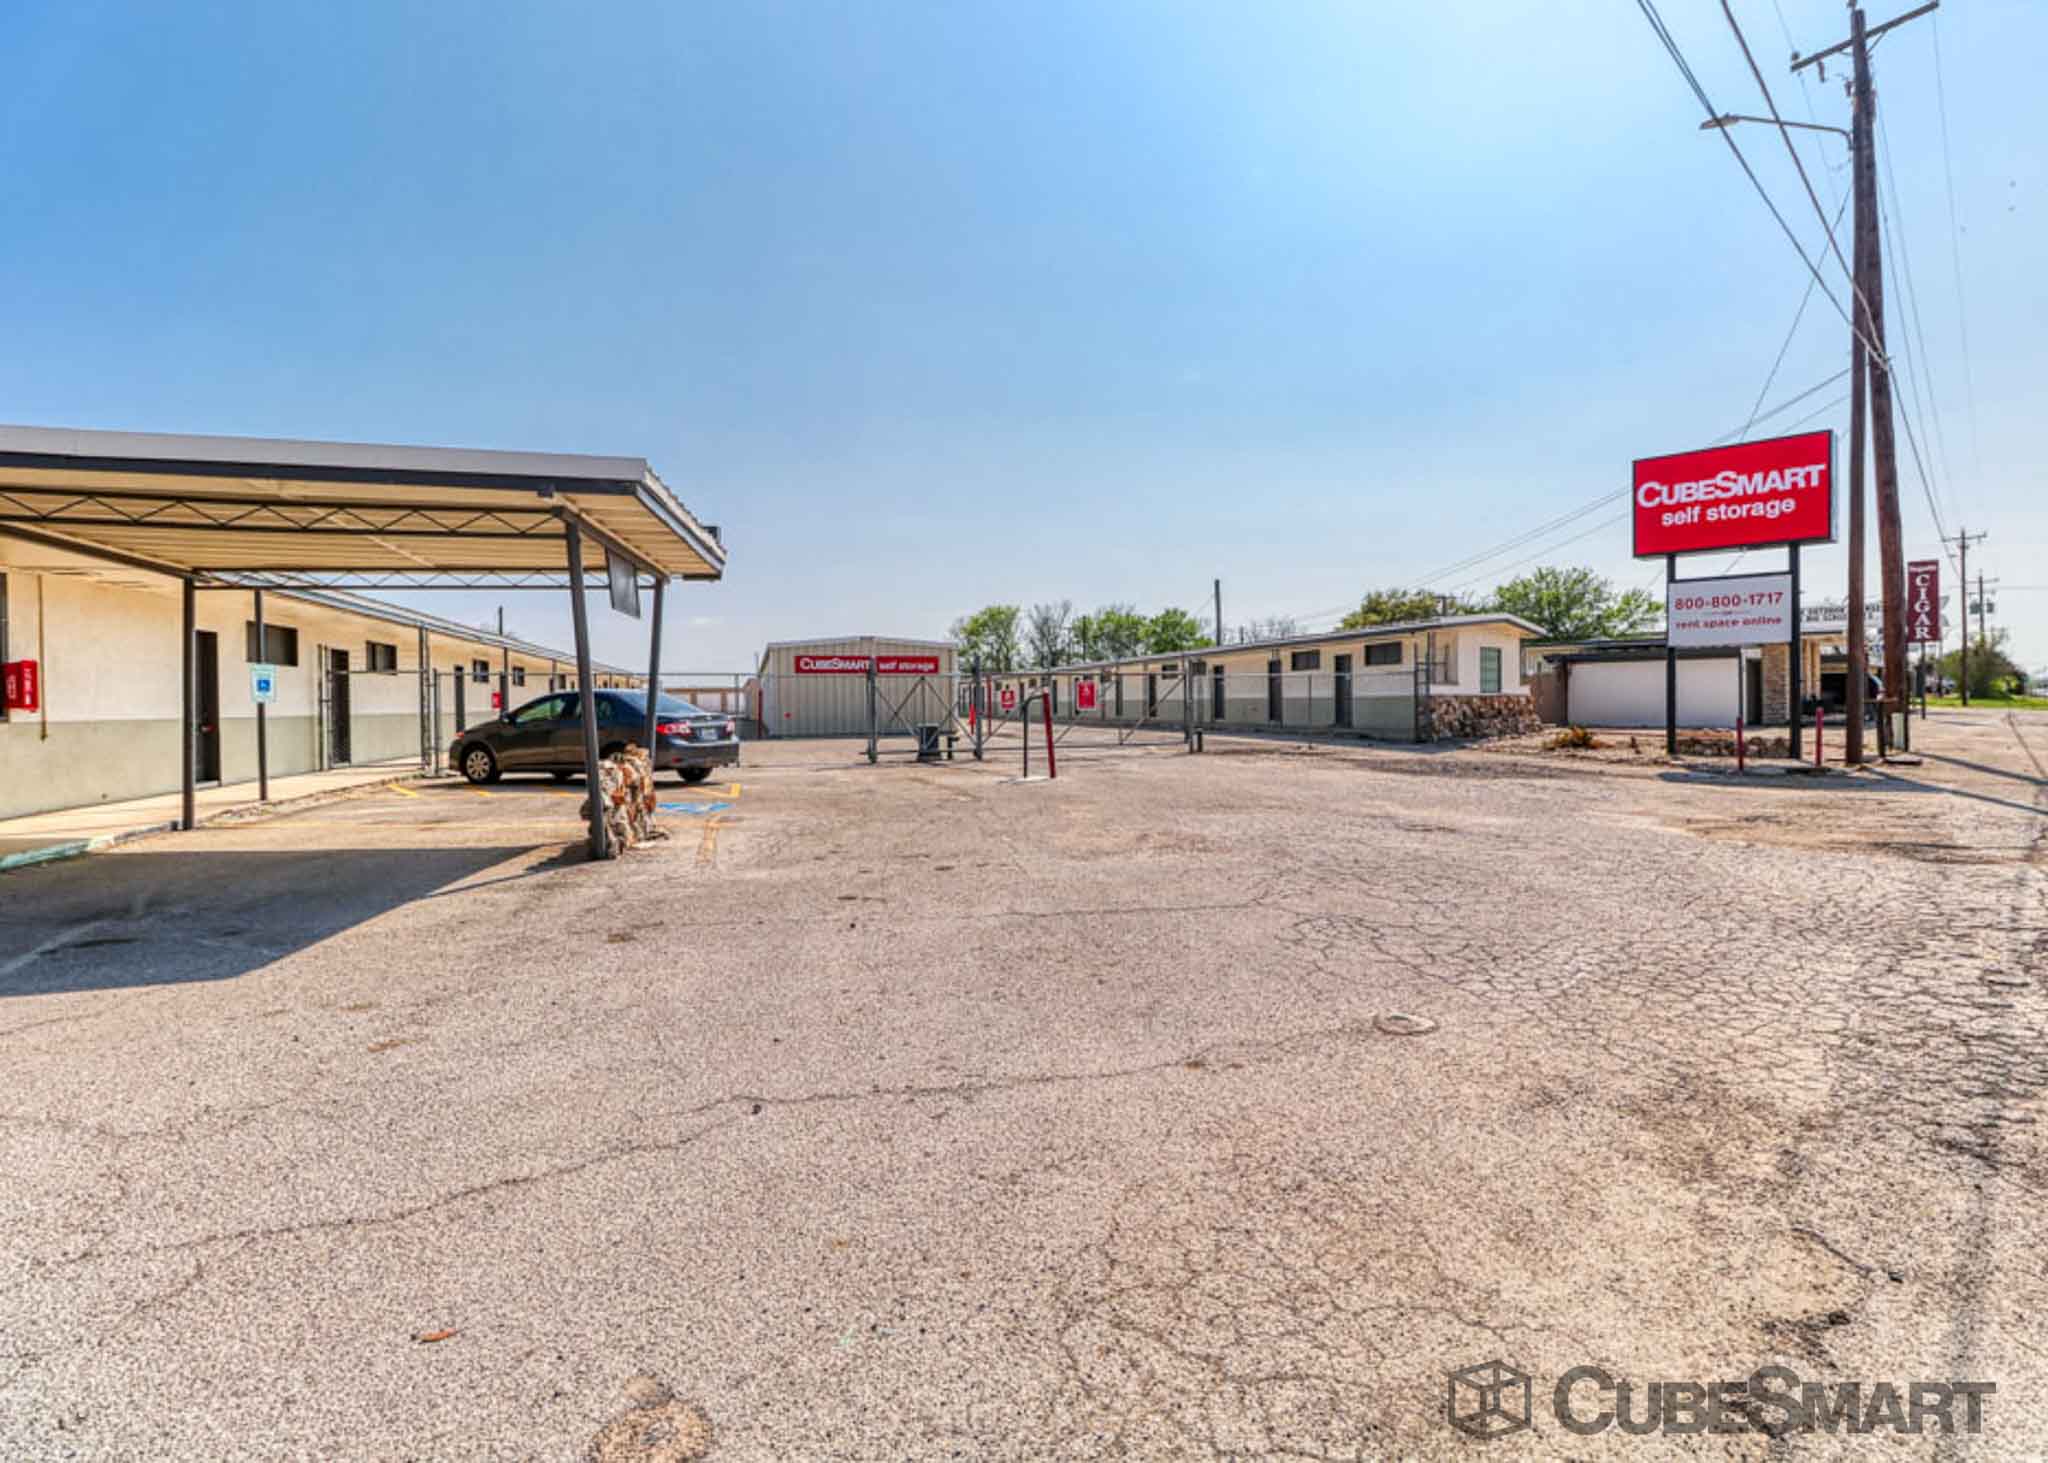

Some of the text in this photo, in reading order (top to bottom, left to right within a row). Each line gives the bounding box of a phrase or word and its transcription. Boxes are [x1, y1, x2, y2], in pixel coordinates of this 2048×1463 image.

[1637, 463, 1827, 508] CUBESMART
[1661, 497, 1797, 526] self storage
[1674, 591, 1784, 610] 800-800-1717
[1913, 573, 1933, 640] CIGAR
[1675, 615, 1782, 631] rent space online
